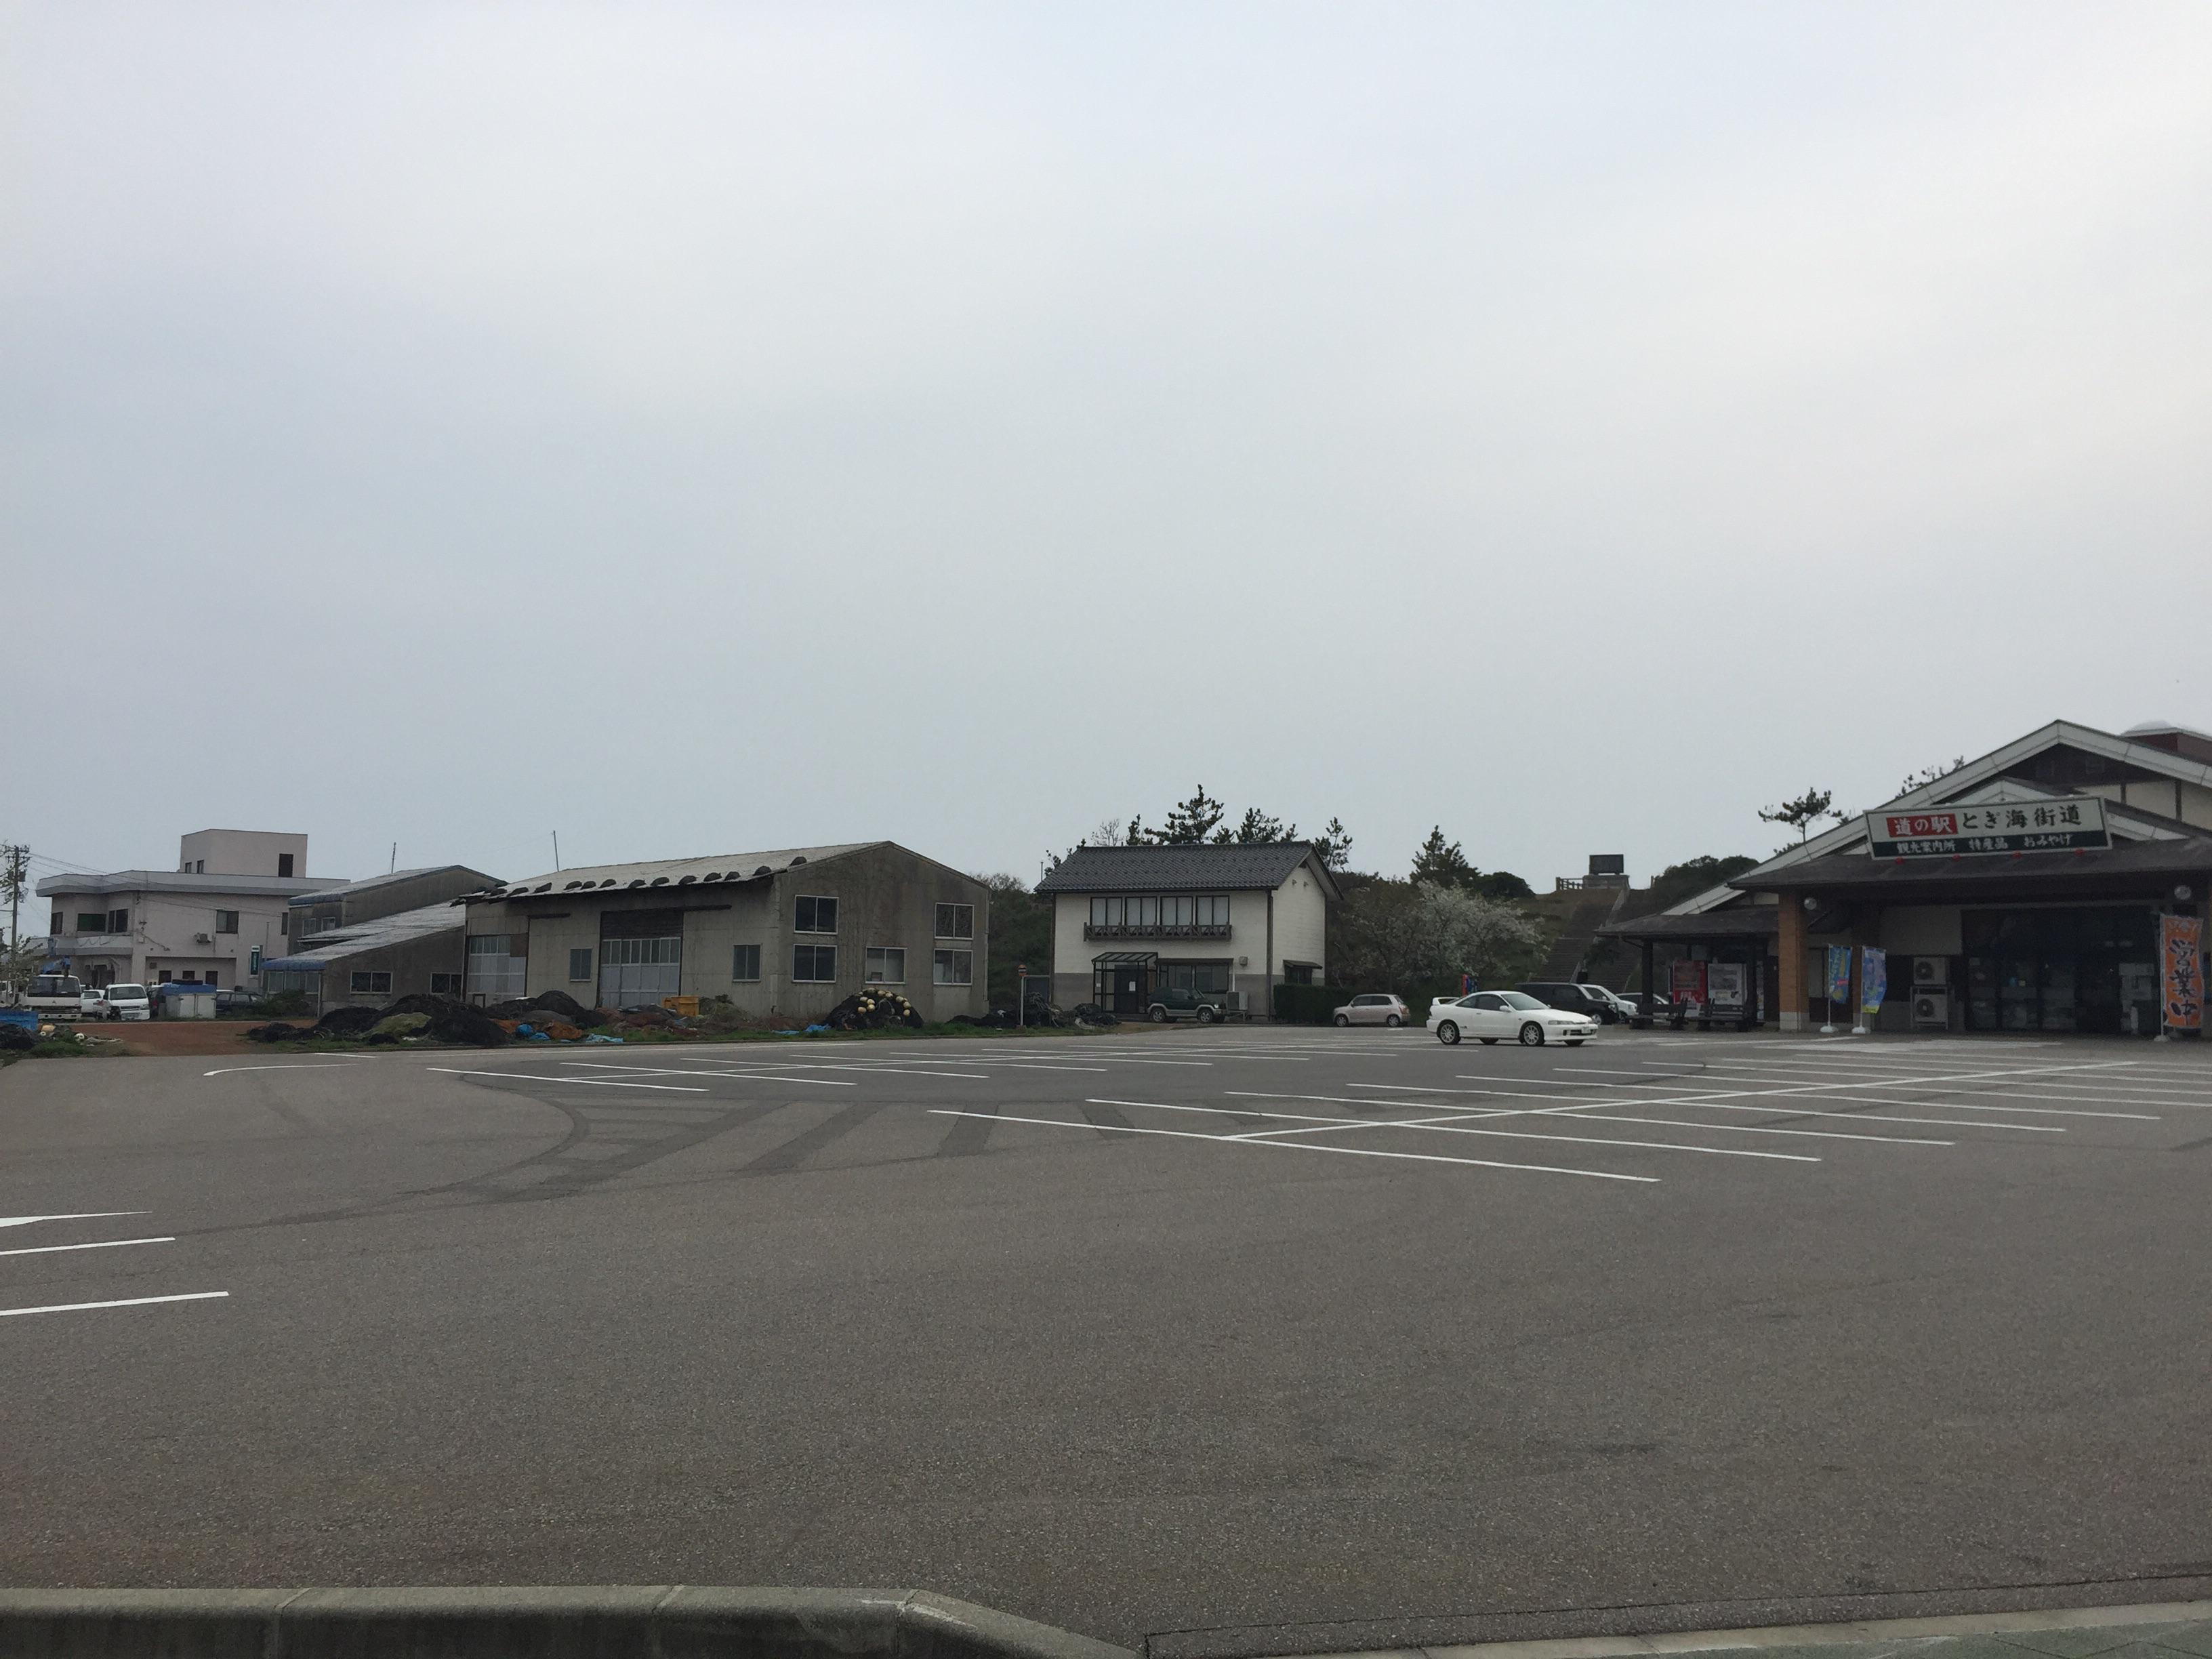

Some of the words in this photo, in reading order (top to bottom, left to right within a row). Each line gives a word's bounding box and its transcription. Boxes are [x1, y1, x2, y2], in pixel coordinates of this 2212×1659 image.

[1893, 815, 1952, 836] 道の駅
[1963, 804, 2082, 830] とぎ海街道
[1896, 840, 1957, 855] 観光案内所
[1968, 836, 2009, 851] 特産品
[2024, 834, 2073, 847] おみやげ
[2169, 939, 2198, 1025] 営業中
